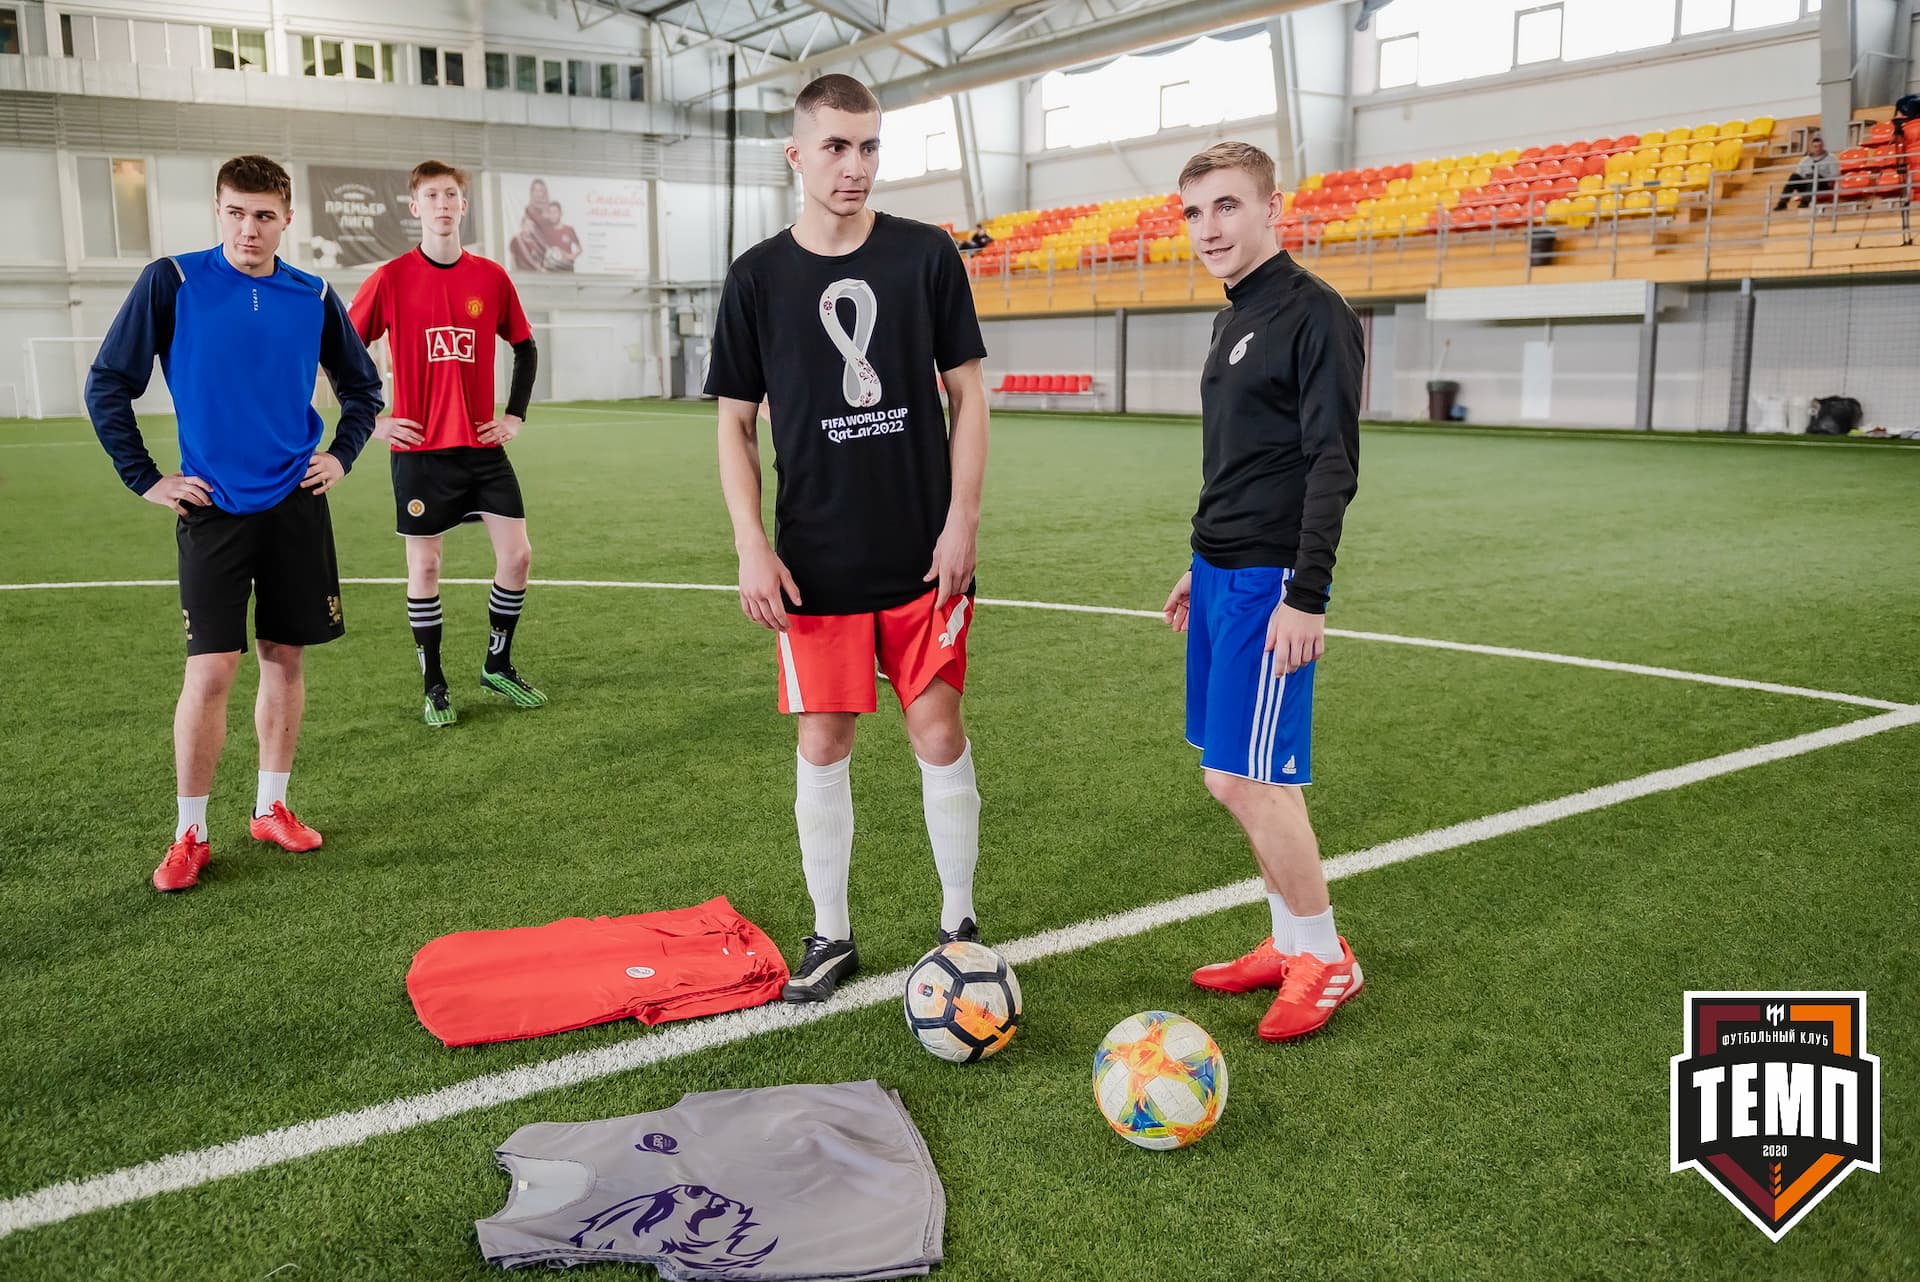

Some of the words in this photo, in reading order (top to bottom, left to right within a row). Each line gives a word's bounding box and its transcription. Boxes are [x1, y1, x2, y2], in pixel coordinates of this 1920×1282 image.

[325, 200, 386, 216] ПРЕМЬЕР
[431, 331, 473, 359] AIG
[1229, 331, 1254, 366] 6
[821, 418, 847, 430] FIFA
[847, 412, 886, 426] WORLD
[887, 407, 909, 420] CUP
